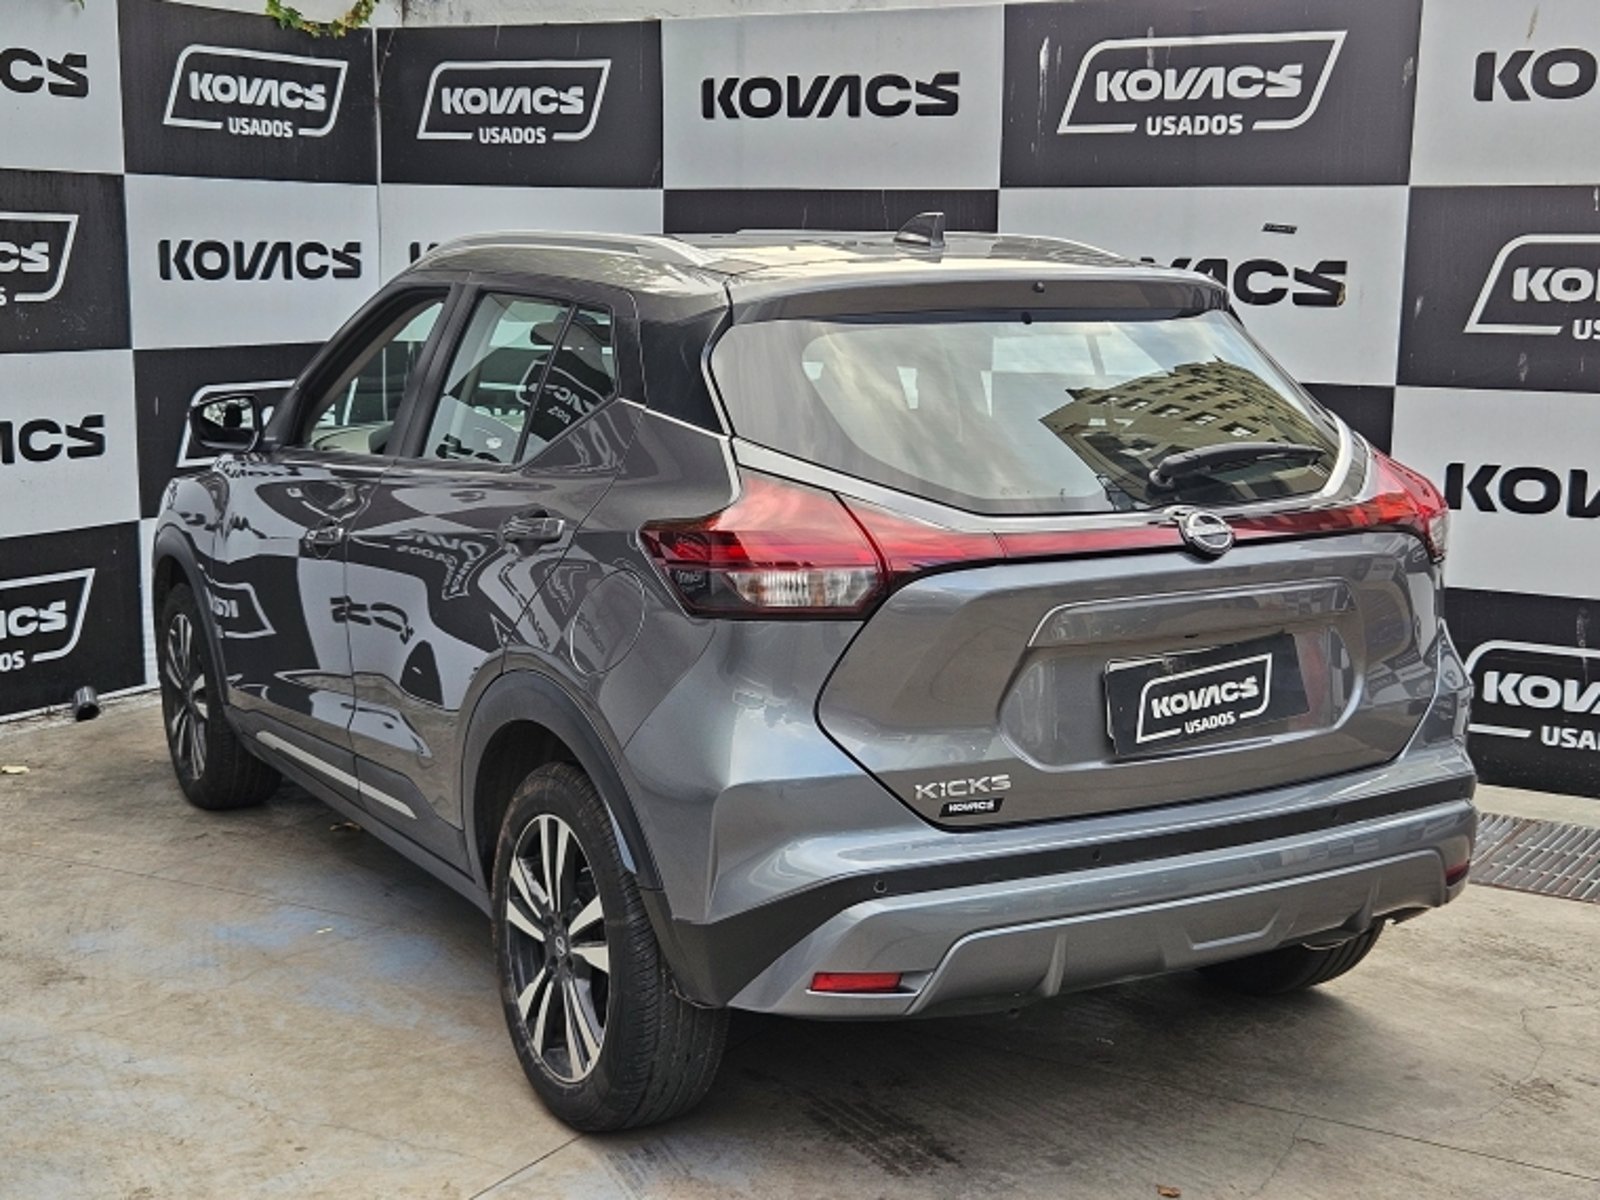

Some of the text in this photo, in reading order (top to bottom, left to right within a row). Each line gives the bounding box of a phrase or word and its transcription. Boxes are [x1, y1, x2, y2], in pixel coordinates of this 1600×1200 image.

[189, 72, 327, 111] KOVACS
[1096, 63, 1303, 103] KOVACS
[1473, 48, 1598, 102] KO
[441, 86, 584, 115] KOVACS
[701, 71, 960, 120] KOVACS
[228, 117, 294, 138] USADOS
[478, 126, 547, 144] USADOS
[1146, 114, 1243, 136] USADOS
[158, 239, 362, 281] KOVACS
[1513, 266, 1600, 303] KO
[0, 600, 67, 640] CS
[1151, 676, 1259, 719] KOVACS
[1483, 670, 1600, 715] KOV
[1184, 711, 1237, 733] USADOS
[1541, 725, 1600, 751] USA
[914, 774, 1011, 800] KICKS
[948, 800, 995, 812] KOVACS
